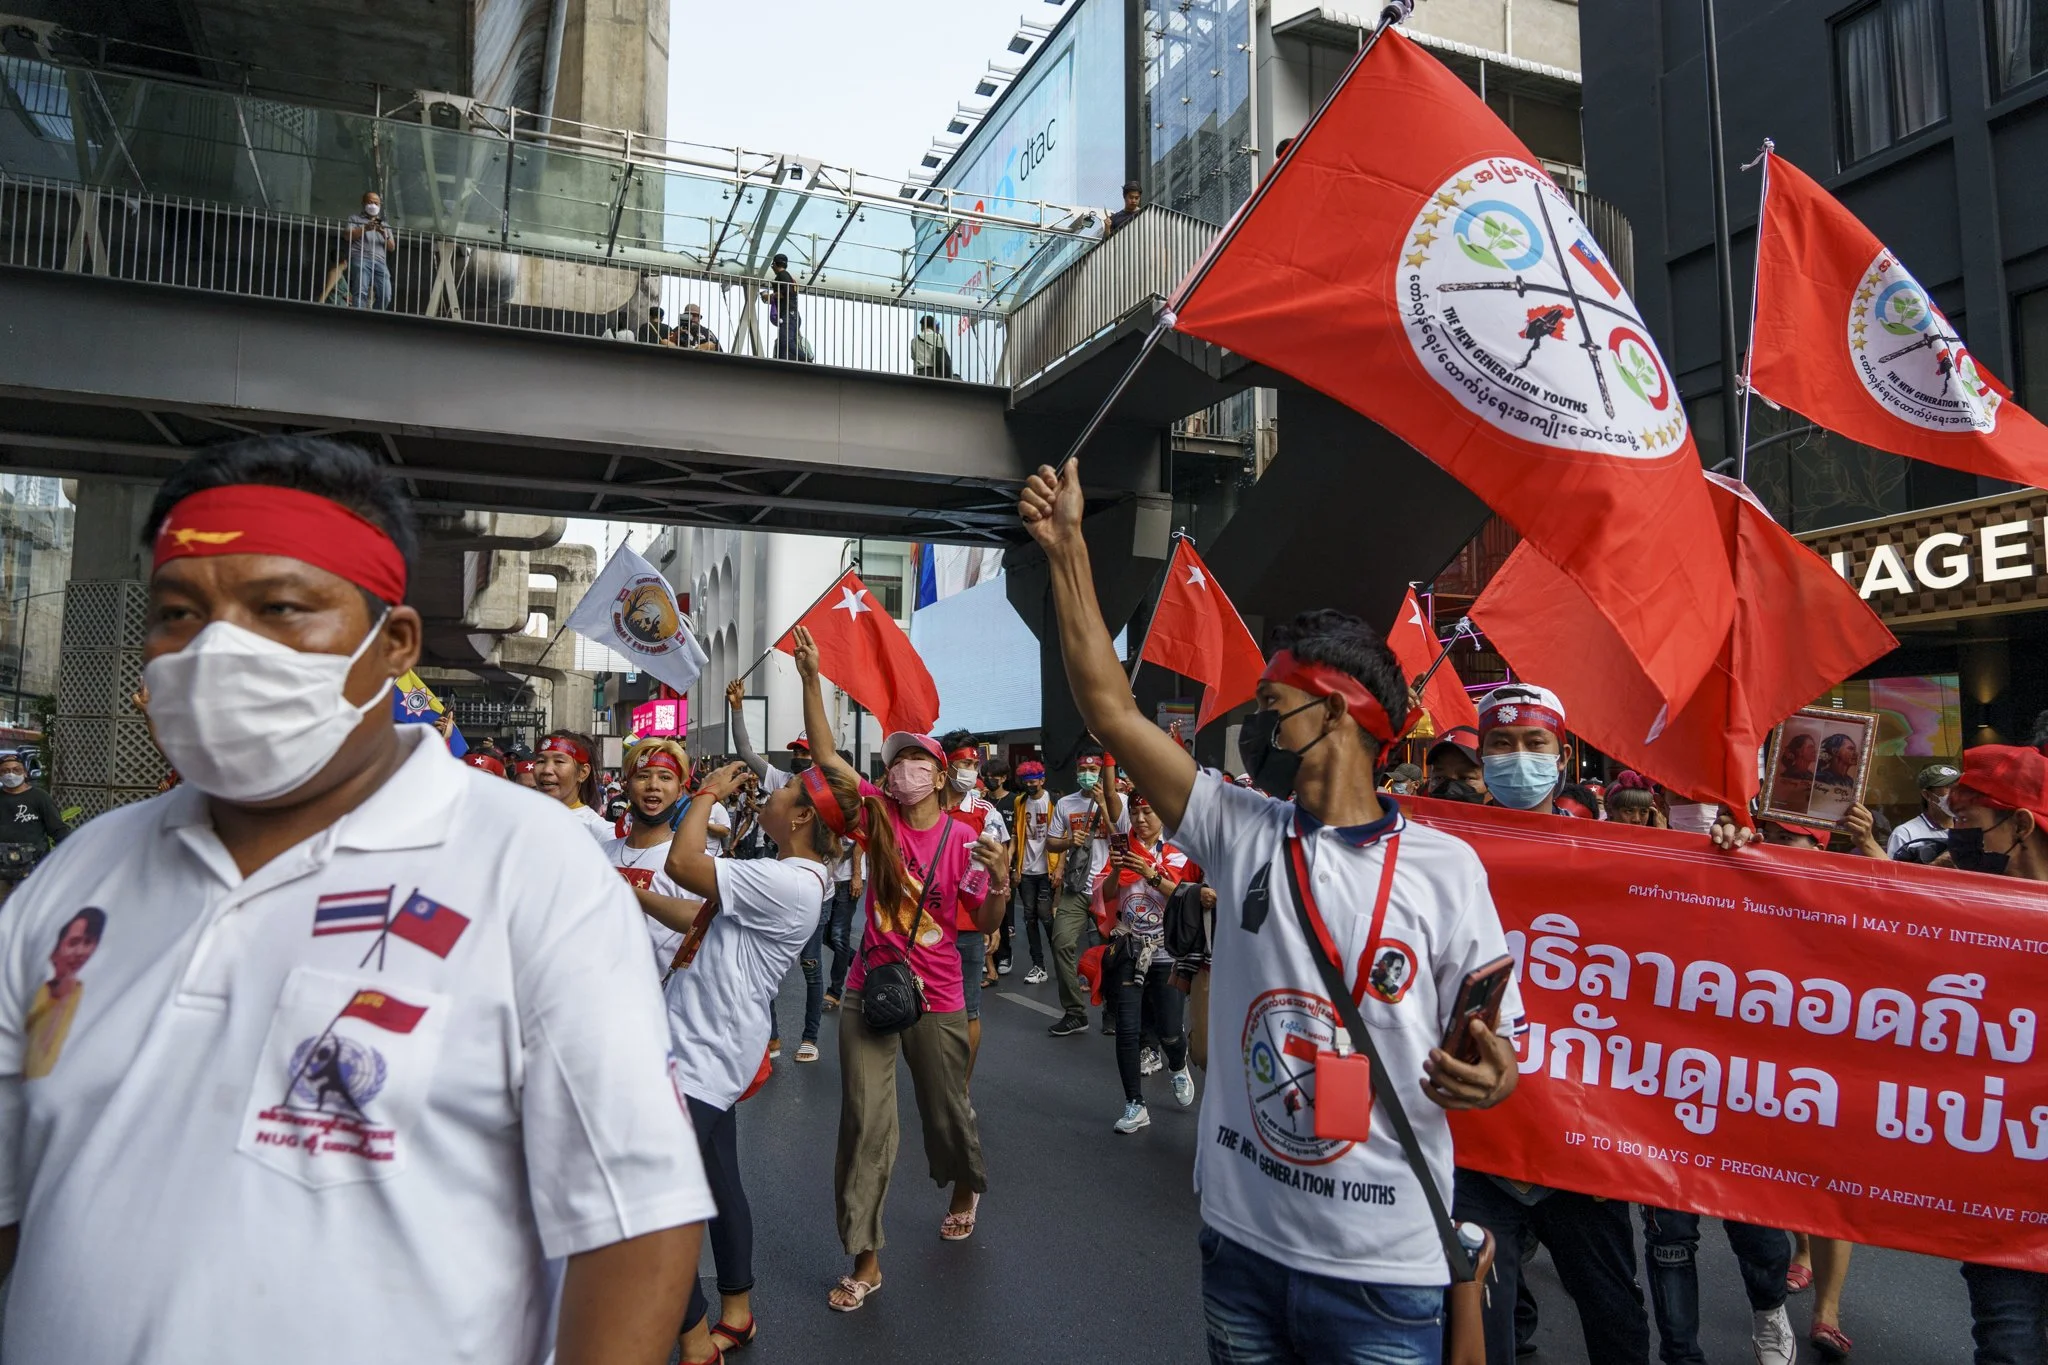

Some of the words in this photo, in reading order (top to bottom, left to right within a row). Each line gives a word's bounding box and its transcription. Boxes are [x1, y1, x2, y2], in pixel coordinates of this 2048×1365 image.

[1020, 118, 1056, 182] dtac
[1443, 306, 1460, 326] THE
[1453, 323, 1477, 350] NEW
[1472, 348, 1540, 396] GENERATION
[1543, 390, 1589, 414] YOUTHS
[1887, 371, 1901, 384] THE
[1901, 381, 1915, 395] NEW
[1914, 391, 1960, 409] GENERATION
[1831, 516, 2048, 600] AGE
[1862, 916, 1901, 933] MAY
[1906, 923, 1943, 940] DAY
[255, 1131, 299, 1148] NUG
[1216, 1125, 1240, 1153] THE
[1240, 1135, 1258, 1167] NEW
[1259, 1154, 1335, 1199] GENERATION
[1342, 1180, 1396, 1206] YOUTHS
[1565, 1131, 1586, 1146] UP
[1592, 1135, 1611, 1150] TO
[1616, 1140, 1642, 1156] 180
[1647, 1145, 1689, 1164] DAYS
[1694, 1153, 1716, 1168] OF
[1720, 1158, 1820, 1187] PREGNANCY
[1825, 1178, 1863, 1197] AND
[1868, 1185, 1956, 1213] PARENTAL
[1962, 1201, 2016, 1221] LEAVE
[2020, 1209, 2048, 1225] FOR
